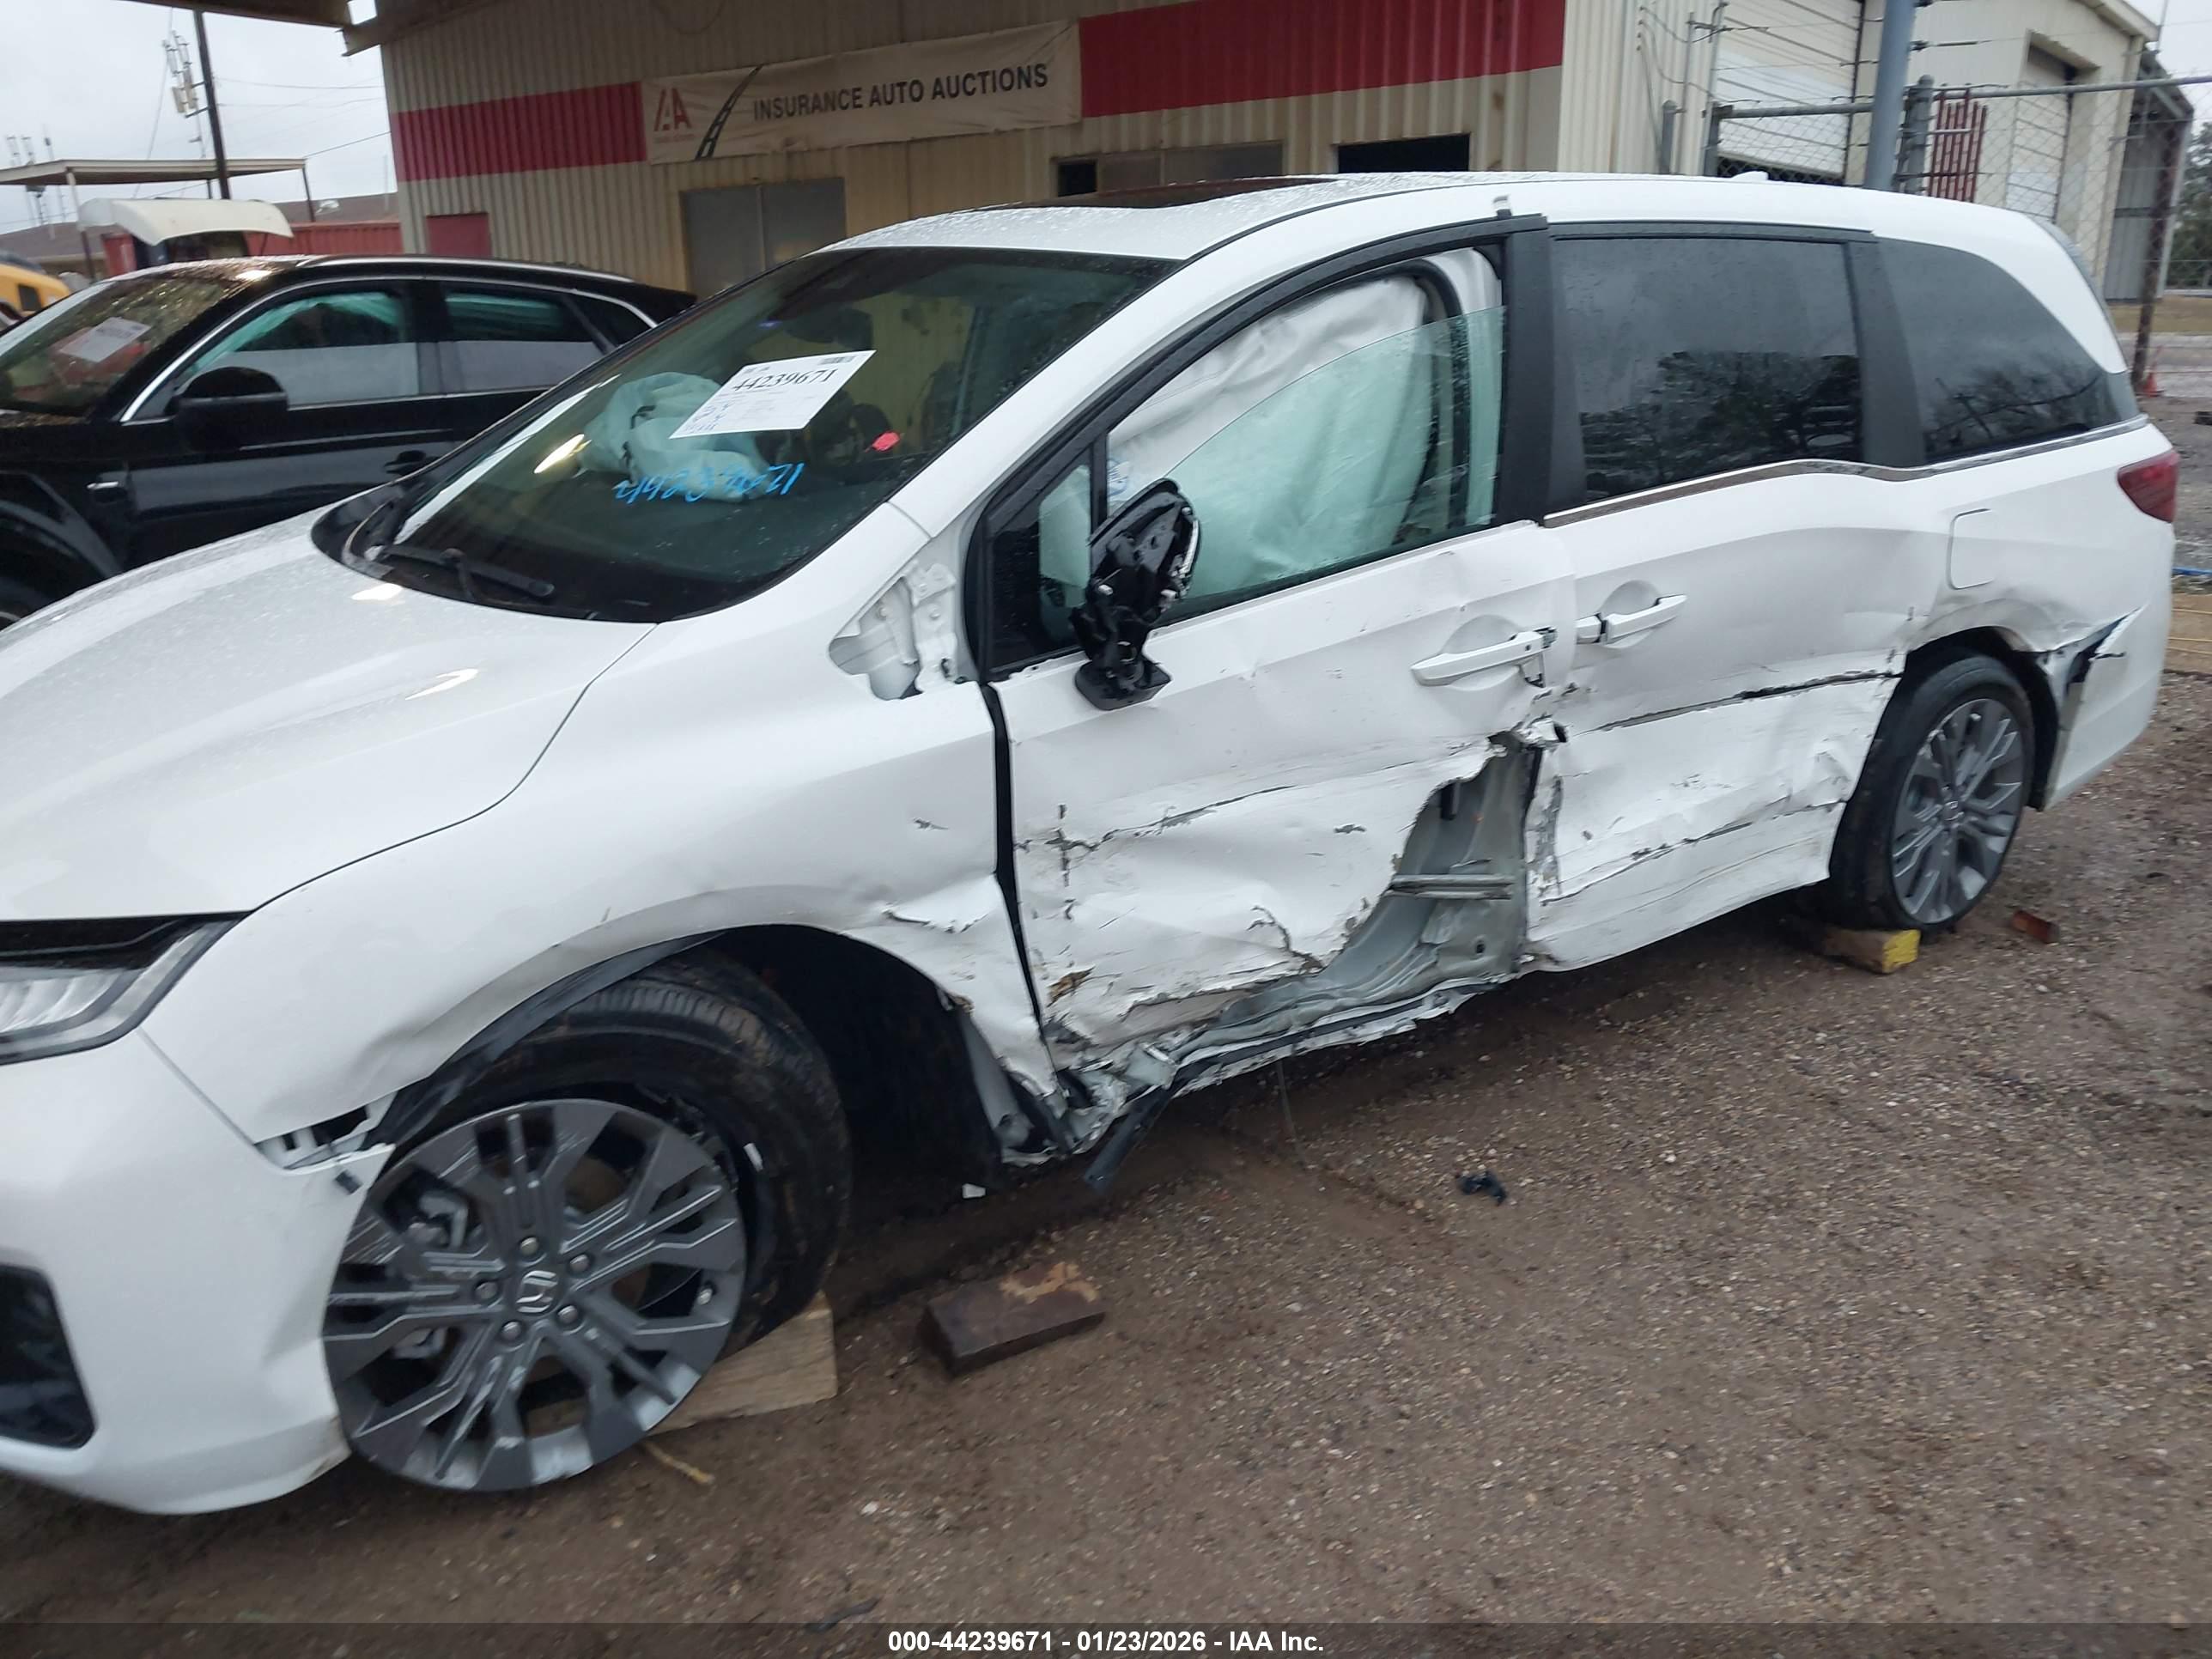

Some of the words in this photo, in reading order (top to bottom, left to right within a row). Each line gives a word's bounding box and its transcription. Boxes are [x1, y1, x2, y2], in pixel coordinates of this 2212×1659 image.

[754, 88, 863, 119] INSURANCE
[869, 80, 924, 107] AUTO
[932, 63, 1048, 100] AUCTIONS
